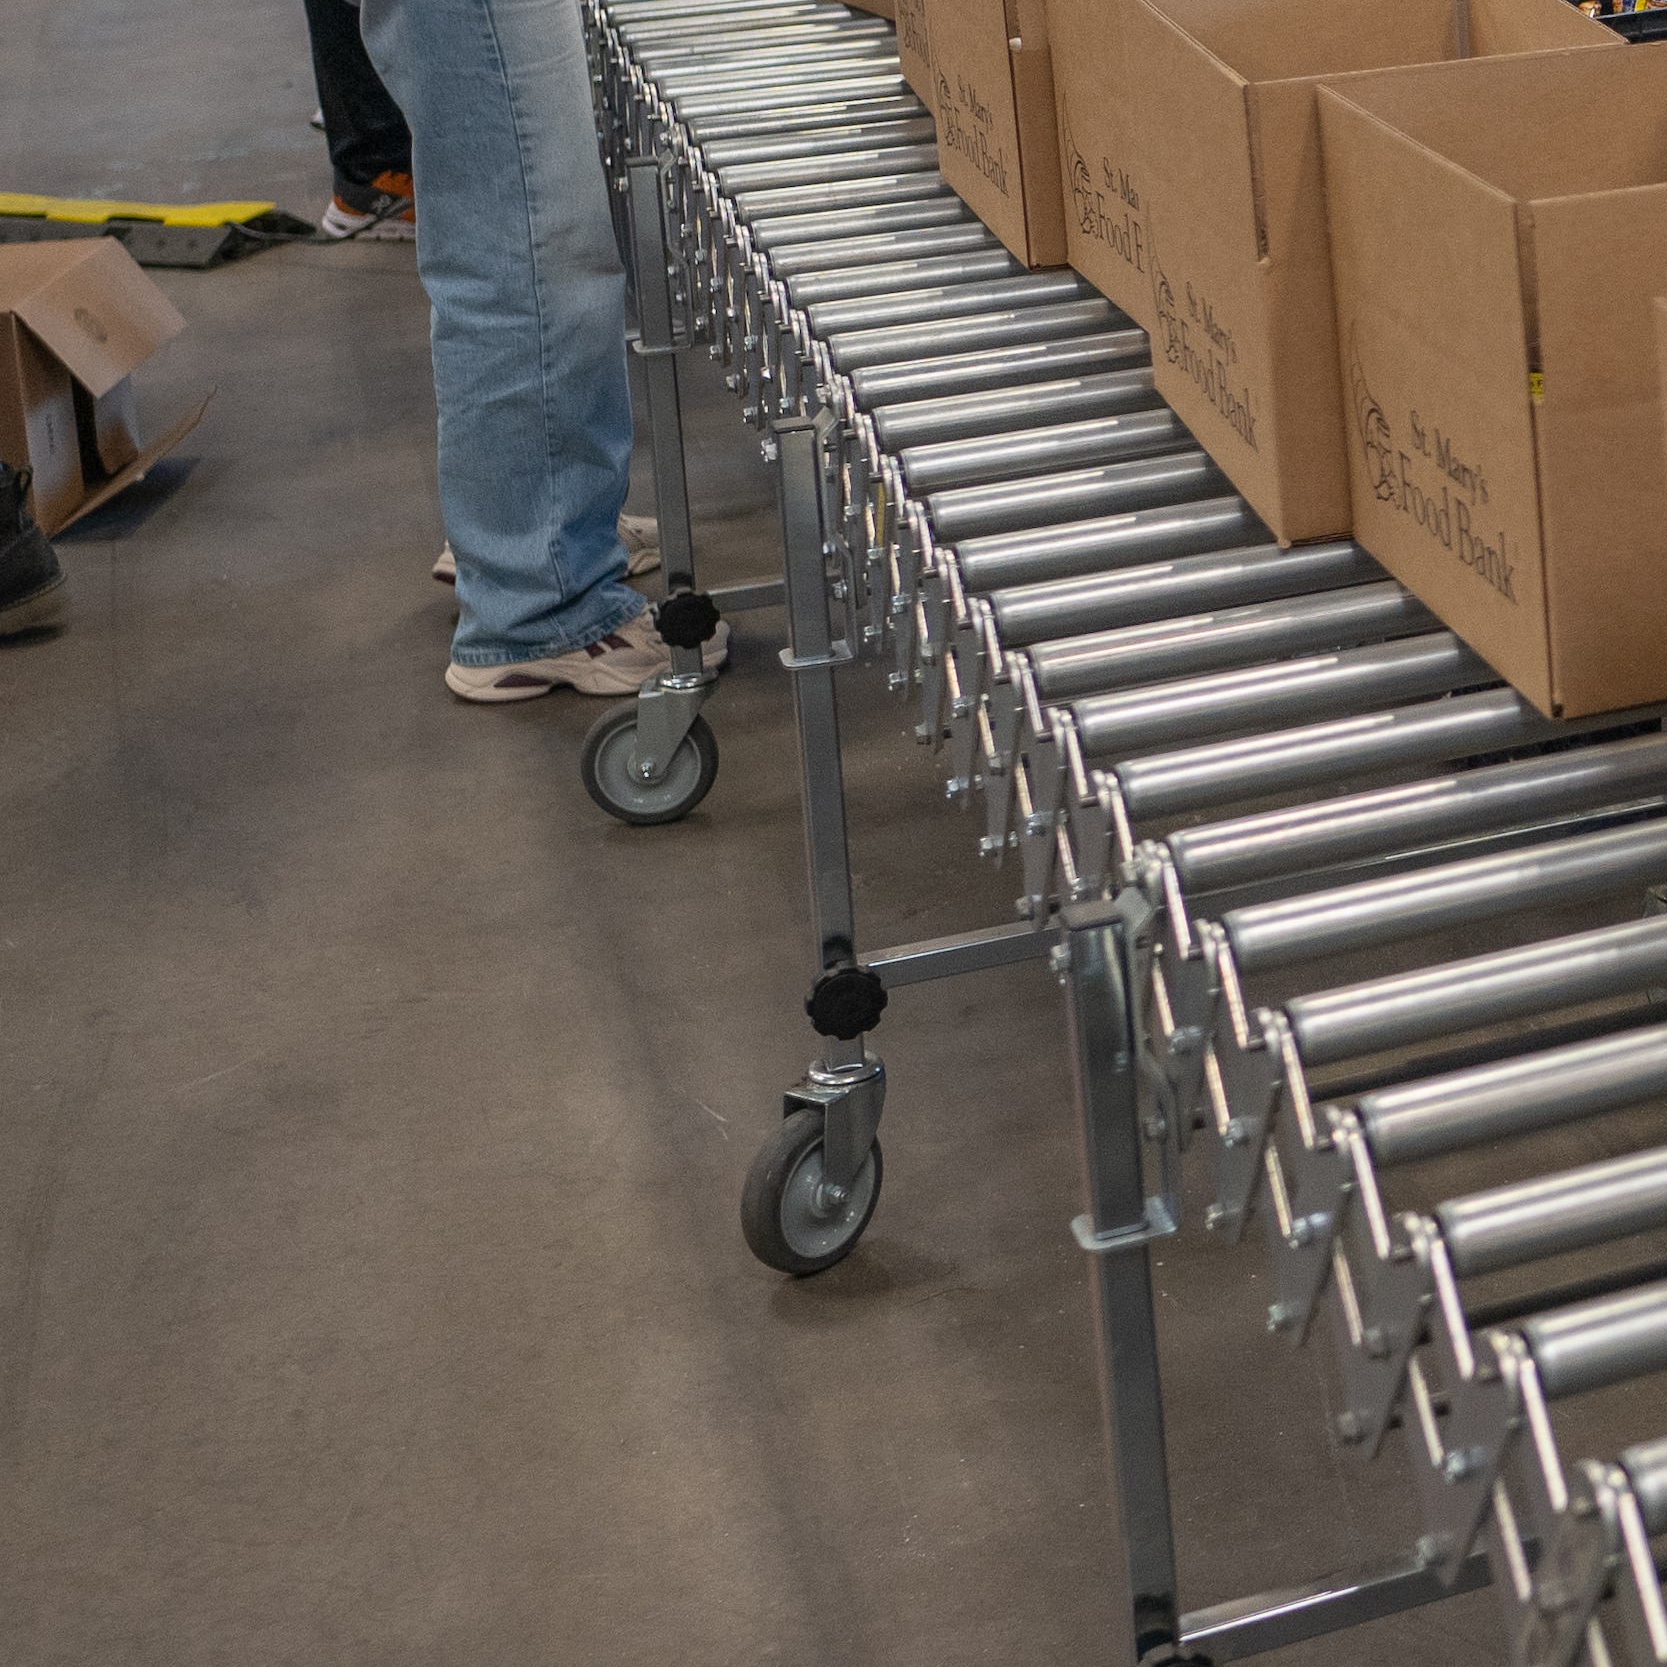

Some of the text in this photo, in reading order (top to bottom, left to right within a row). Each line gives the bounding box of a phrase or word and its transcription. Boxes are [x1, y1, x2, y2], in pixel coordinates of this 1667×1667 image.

[957, 74, 994, 132] St. Mary's
[954, 107, 1010, 199] Food Bank
[1103, 156, 1118, 193] St.
[1095, 190, 1133, 263] Food
[1187, 280, 1239, 367] St. Mary's
[1180, 317, 1261, 455] Food Bank
[1411, 410, 1490, 507] St. Mary's
[1398, 449, 1519, 607] Food Bank
